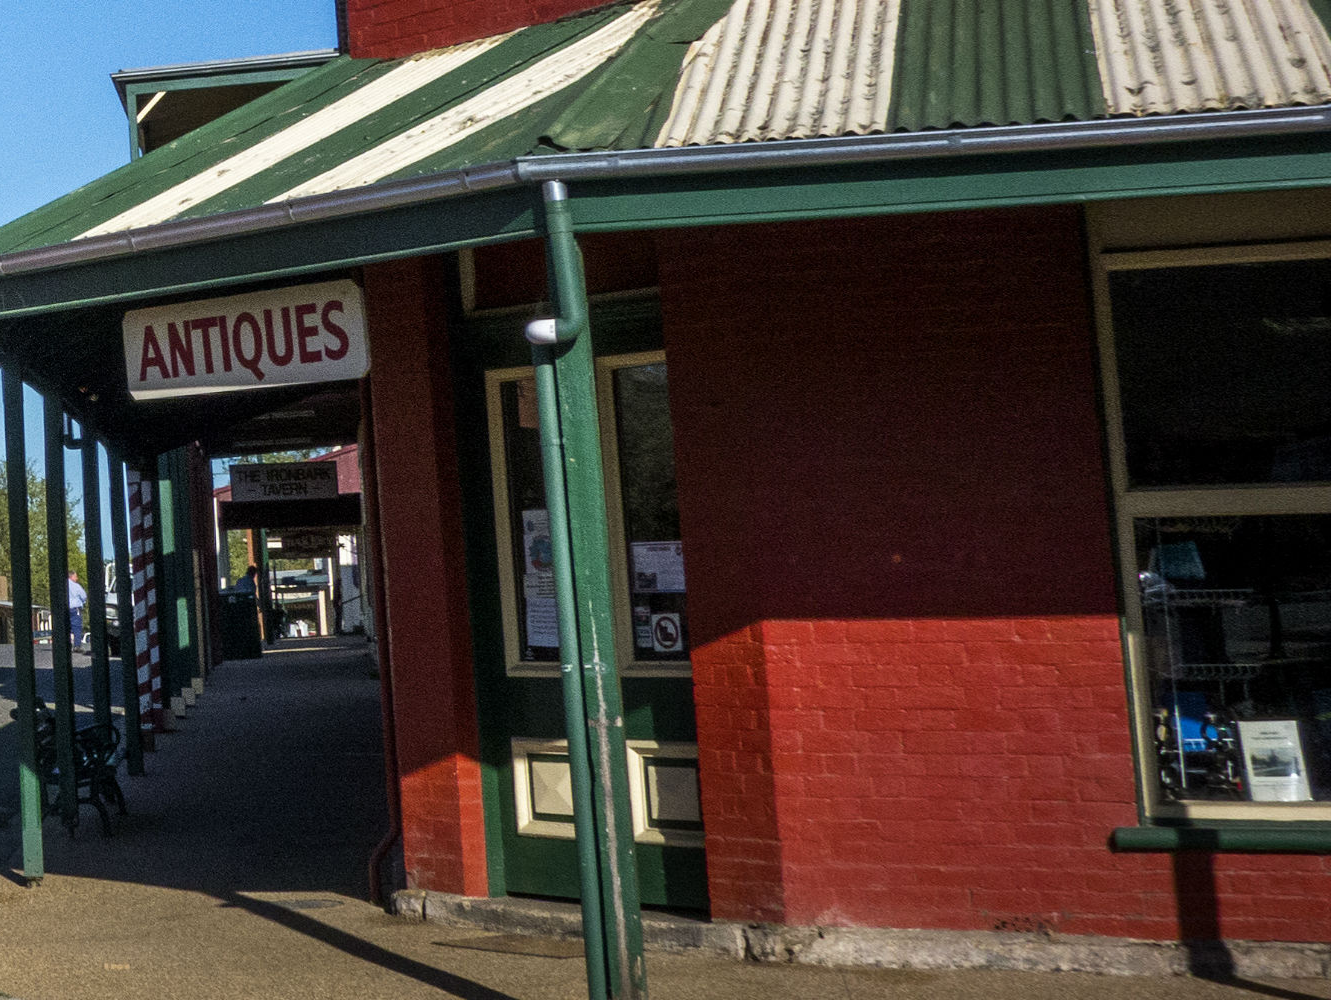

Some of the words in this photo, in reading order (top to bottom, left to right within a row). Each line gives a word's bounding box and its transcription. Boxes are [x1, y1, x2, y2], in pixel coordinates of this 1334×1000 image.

[139, 300, 350, 381] ANTIQUES
[236, 470, 261, 483] THE
[266, 467, 331, 482] IRONBARK
[261, 482, 308, 496] TAVERN
